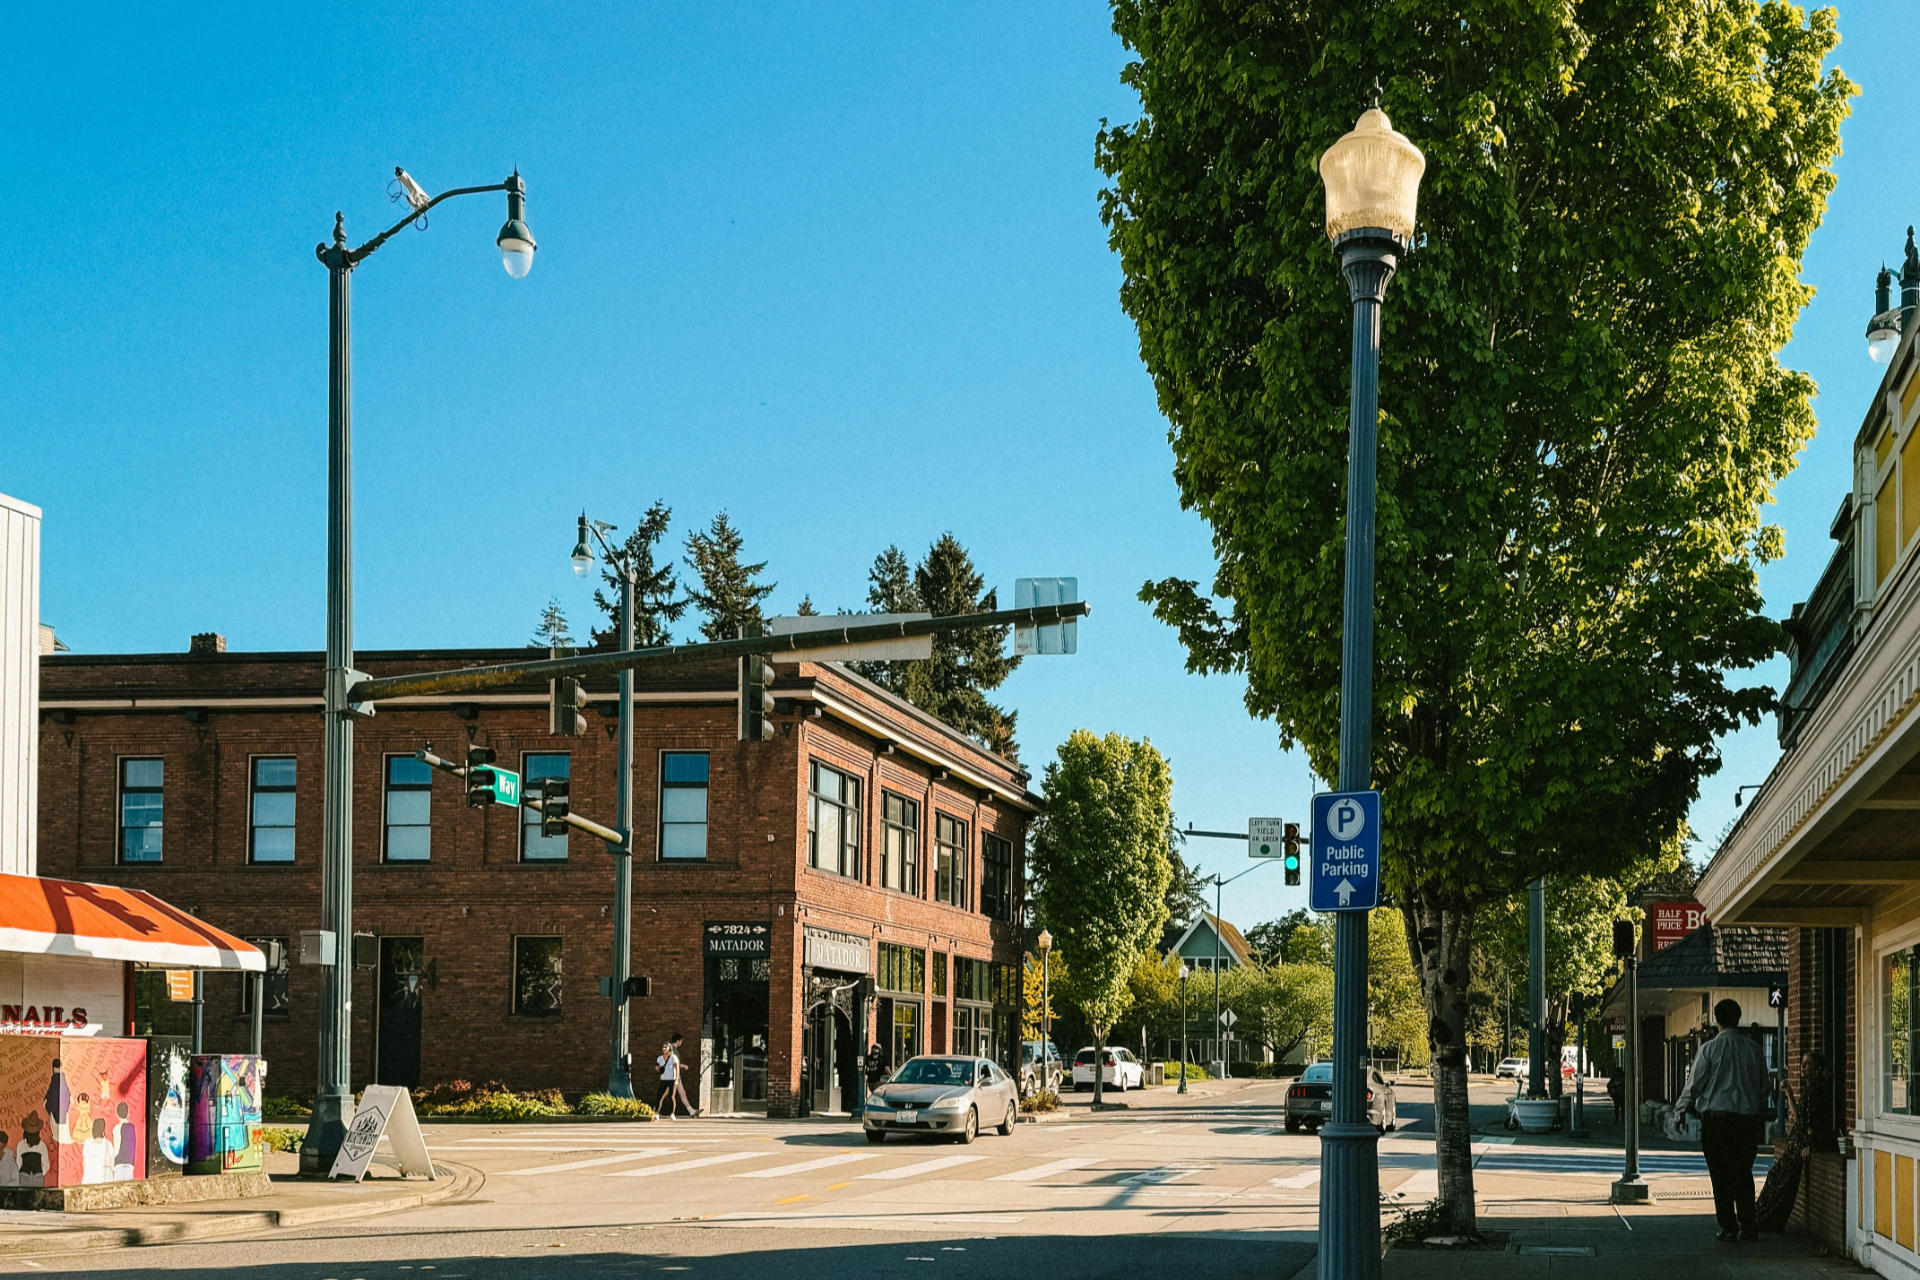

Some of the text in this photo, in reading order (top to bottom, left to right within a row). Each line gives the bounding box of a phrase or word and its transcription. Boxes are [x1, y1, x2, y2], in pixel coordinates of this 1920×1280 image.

[499, 773, 516, 800] Way
[1337, 806, 1356, 833] P
[1257, 827, 1275, 835] YIELD
[1326, 845, 1365, 861] Public
[1321, 861, 1369, 878] Parking
[1658, 909, 1681, 918] HALF
[1685, 910, 1707, 930] B
[723, 925, 751, 935] 7824
[1657, 921, 1682, 930] PRICE
[709, 940, 765, 951] MATADOR
[816, 943, 861, 968] MATADOR
[1, 1005, 88, 1029] NAILS
[7, 1051, 53, 1086] COMMUNITY
